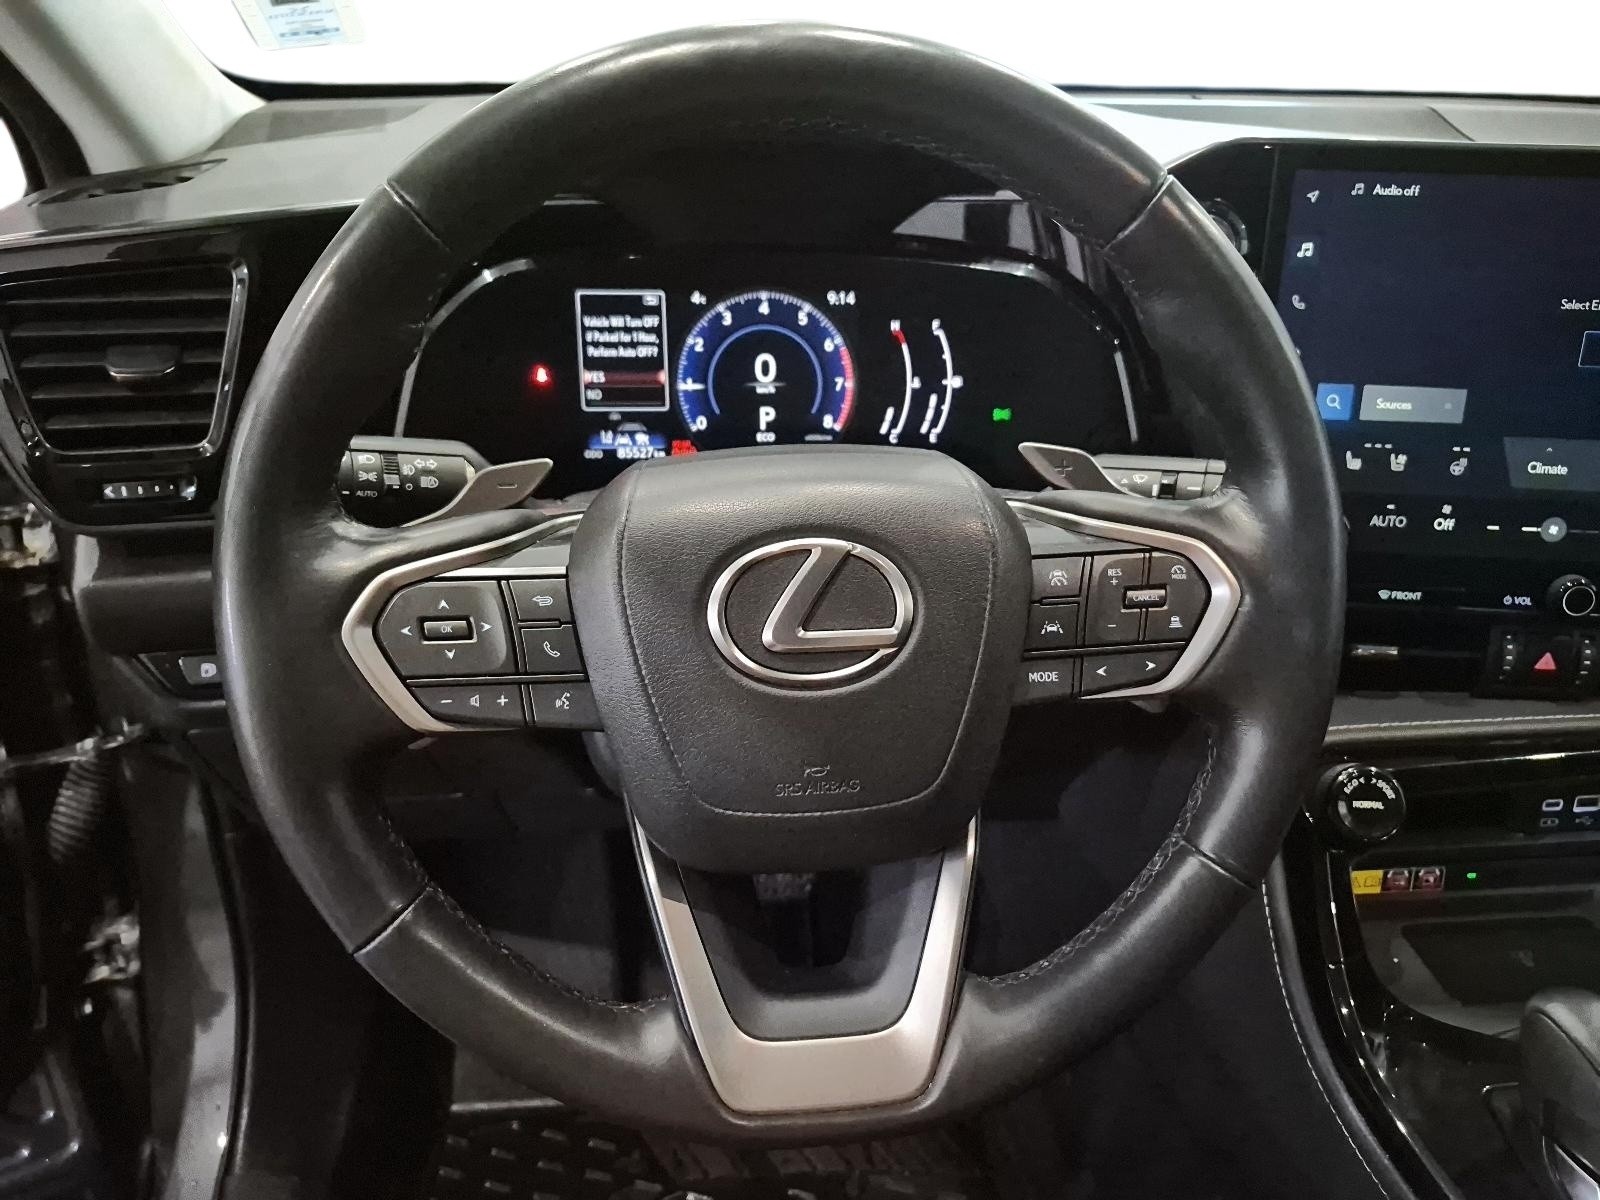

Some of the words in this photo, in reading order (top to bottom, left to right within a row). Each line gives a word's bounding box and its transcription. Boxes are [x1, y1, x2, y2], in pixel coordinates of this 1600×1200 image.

[1373, 183, 1403, 195] Audio
[1404, 184, 1420, 196] off
[758, 300, 769, 315] 4
[1561, 299, 1590, 310] Select
[1592, 299, 1600, 311] E
[721, 310, 732, 326] 3
[798, 310, 808, 326] 5
[694, 336, 704, 352] 2
[824, 337, 834, 352] 6
[754, 353, 777, 383] 0
[834, 377, 844, 392] 7
[1376, 398, 1412, 410] Sources
[696, 415, 707, 430] 0
[759, 406, 776, 431] P
[823, 414, 833, 429] 8
[1528, 462, 1568, 475] Climate
[356, 489, 378, 497] AUTO
[1370, 515, 1407, 528] AUTO
[1433, 518, 1456, 532] Off
[1391, 591, 1422, 600] FRONT
[1514, 596, 1532, 605] VOL
[441, 624, 453, 634] OK
[1028, 672, 1059, 682] MODE
[776, 783, 802, 797] SRS
[805, 780, 860, 795] AIRBAG
[1376, 780, 1396, 799] SPORT
[1352, 800, 1385, 810] NORMAL
